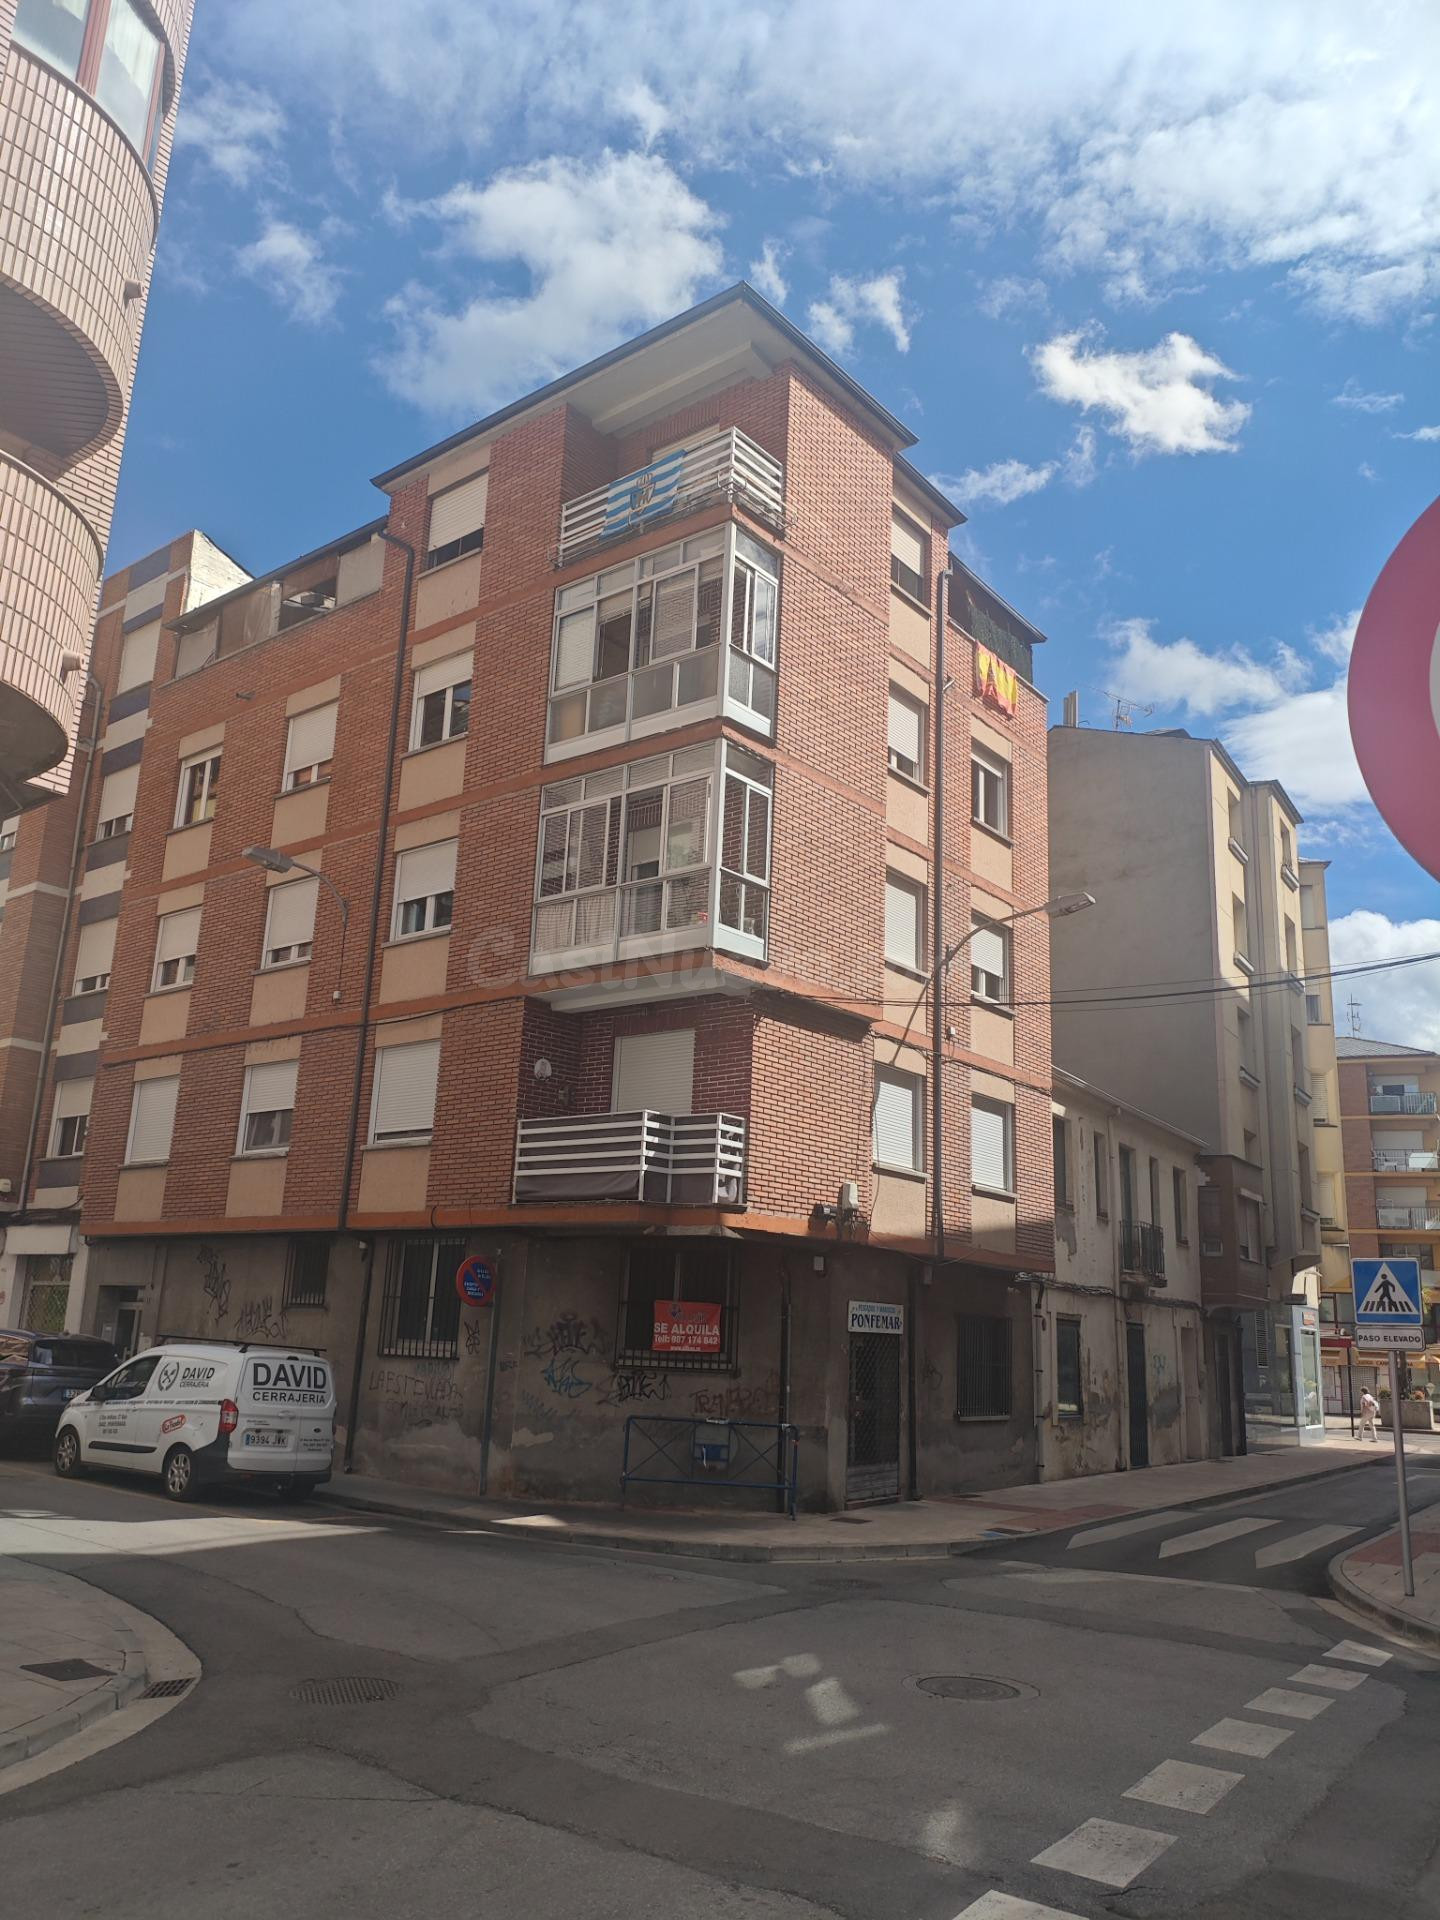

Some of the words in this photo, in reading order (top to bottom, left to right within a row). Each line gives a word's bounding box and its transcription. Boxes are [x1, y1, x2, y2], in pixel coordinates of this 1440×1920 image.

[851, 1313, 901, 1330] PONFEMAR
[653, 1322, 669, 1335] SE
[671, 1323, 721, 1336] ALQUILA
[688, 1335, 702, 1345] 174
[1358, 1334, 1381, 1342] PASO
[1383, 1335, 1421, 1344] ELEVADO
[181, 1366, 215, 1380] DAVID
[253, 1362, 327, 1390] DAVID
[252, 1391, 326, 1404] CERRAJERIA
